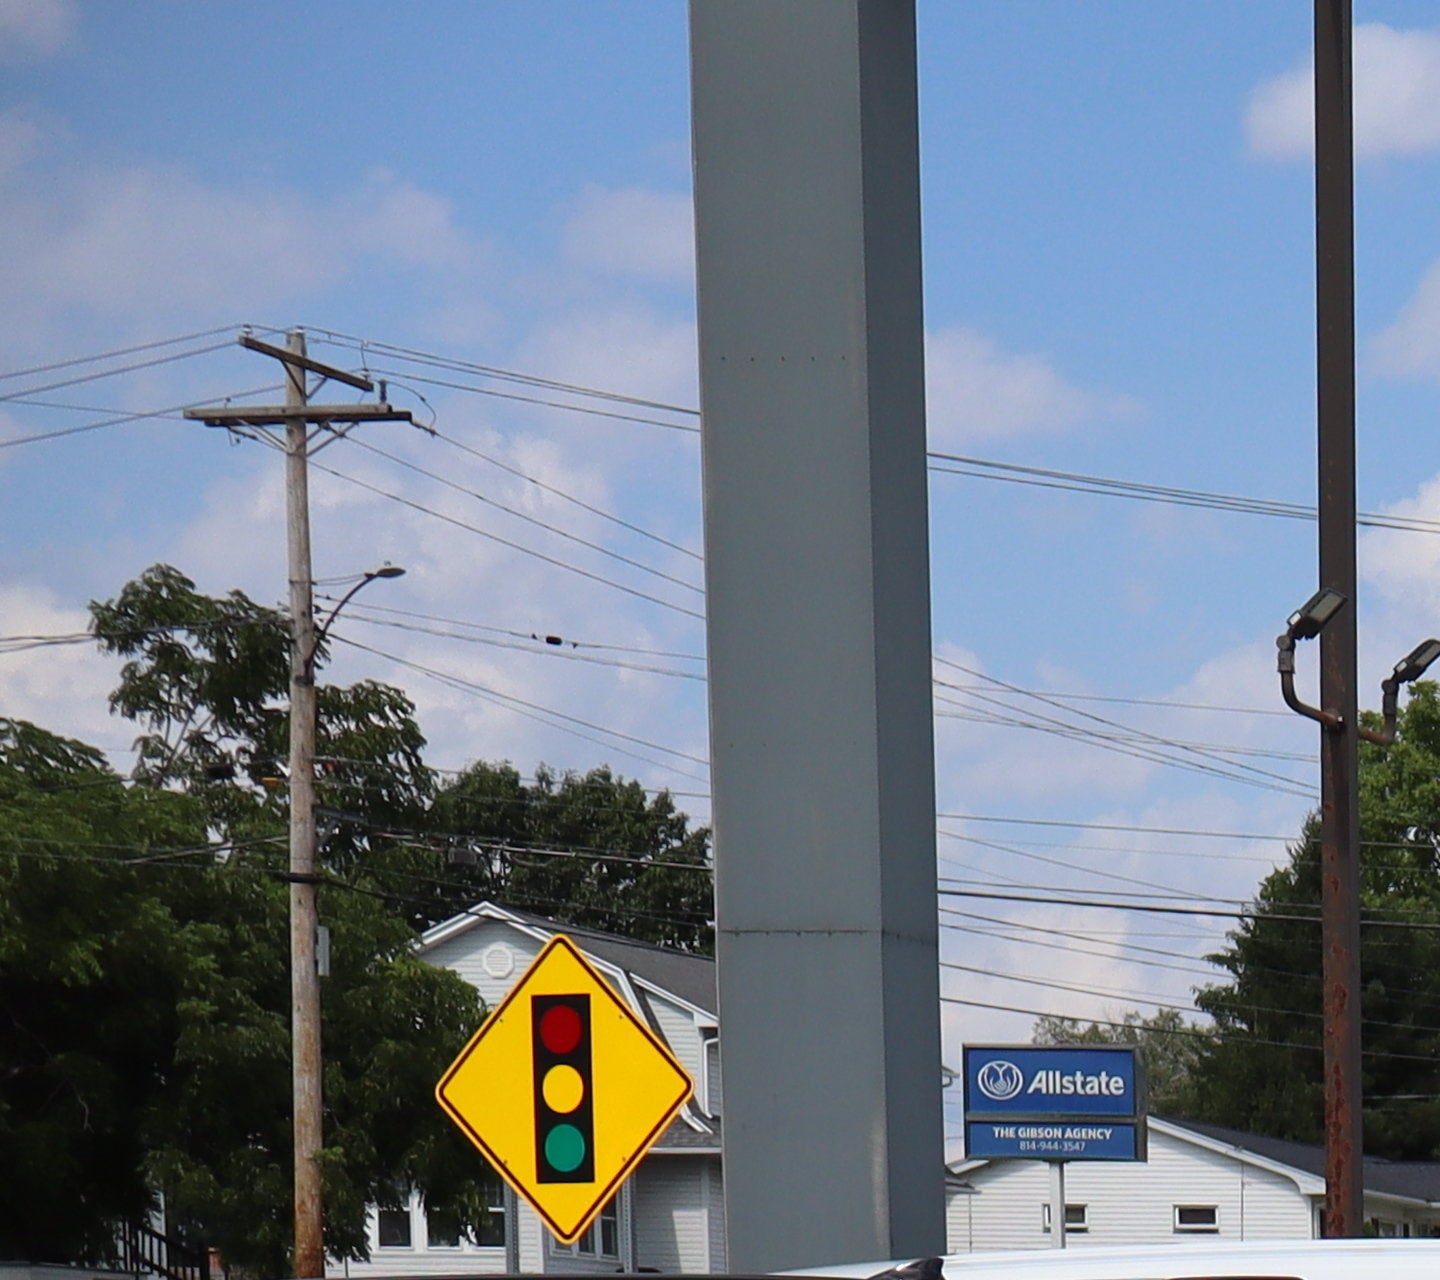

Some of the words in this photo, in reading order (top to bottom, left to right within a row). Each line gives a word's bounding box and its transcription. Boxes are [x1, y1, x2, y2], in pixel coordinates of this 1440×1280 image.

[1027, 1070, 1124, 1096] Allstate
[993, 1127, 1016, 1138] THE
[1018, 1127, 1062, 1139] GIBSON
[1064, 1128, 1112, 1140] AGENCY
[1019, 1140, 1086, 1152] 814-944-3547
